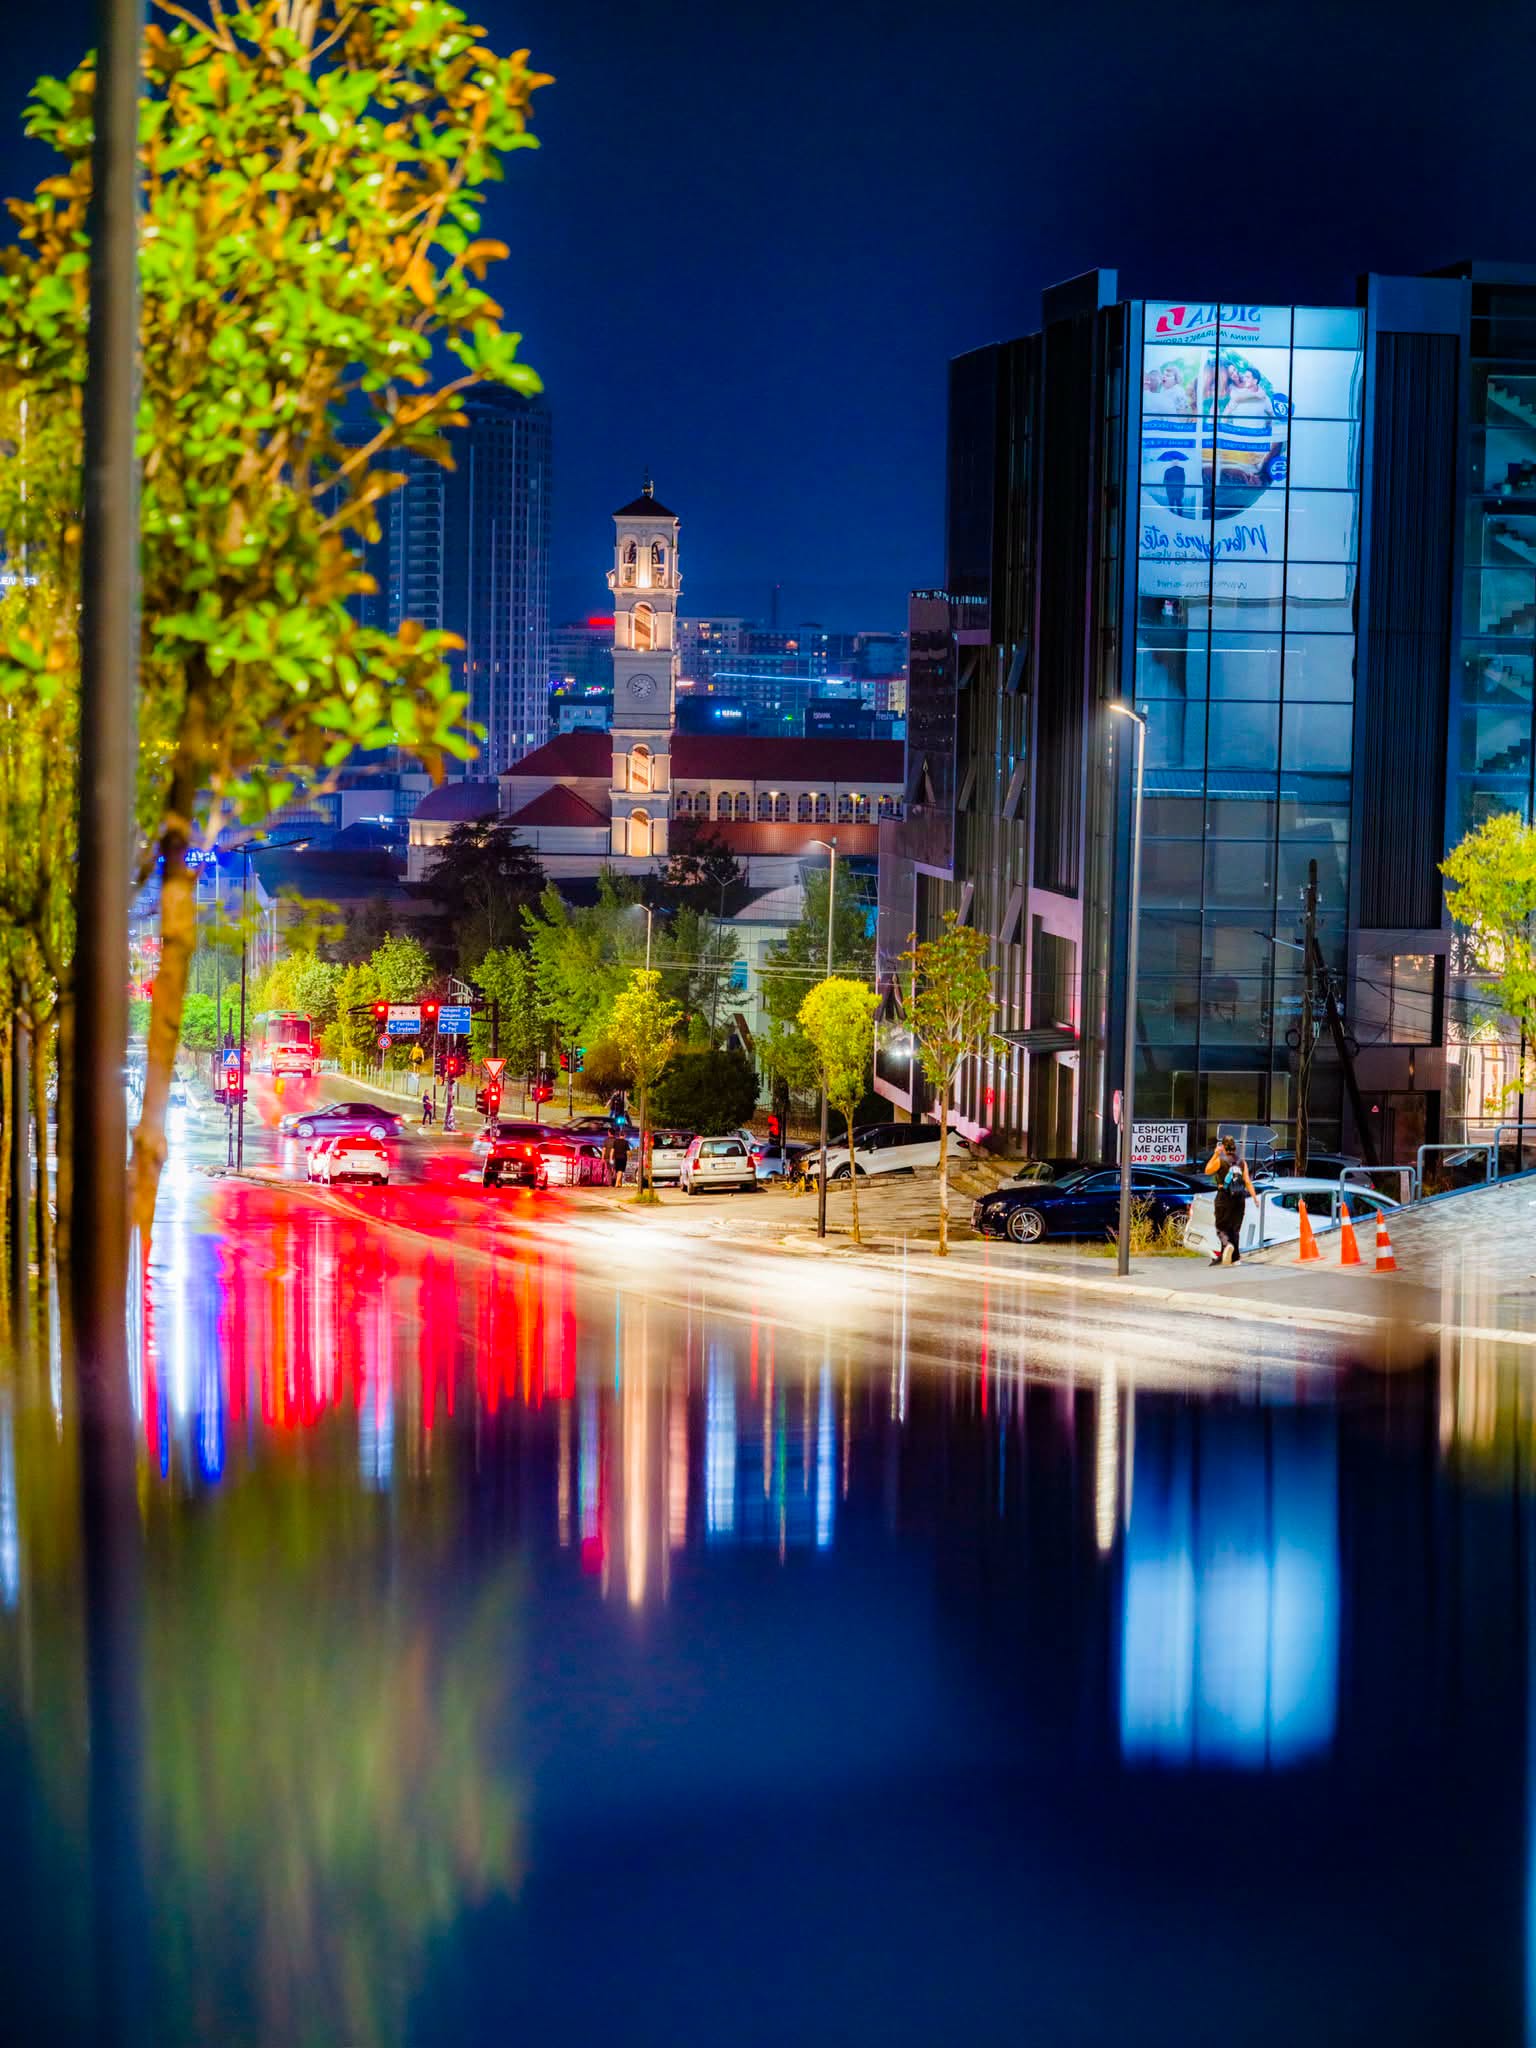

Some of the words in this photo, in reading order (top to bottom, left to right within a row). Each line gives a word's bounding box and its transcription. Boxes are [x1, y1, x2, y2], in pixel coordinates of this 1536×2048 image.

[0, 576, 37, 586] ENER
[1132, 1125, 1185, 1134] LESHOHET
[1138, 1135, 1180, 1143] OBJEKTI
[1135, 1145, 1151, 1153] ME
[1154, 1145, 1182, 1154] QERA
